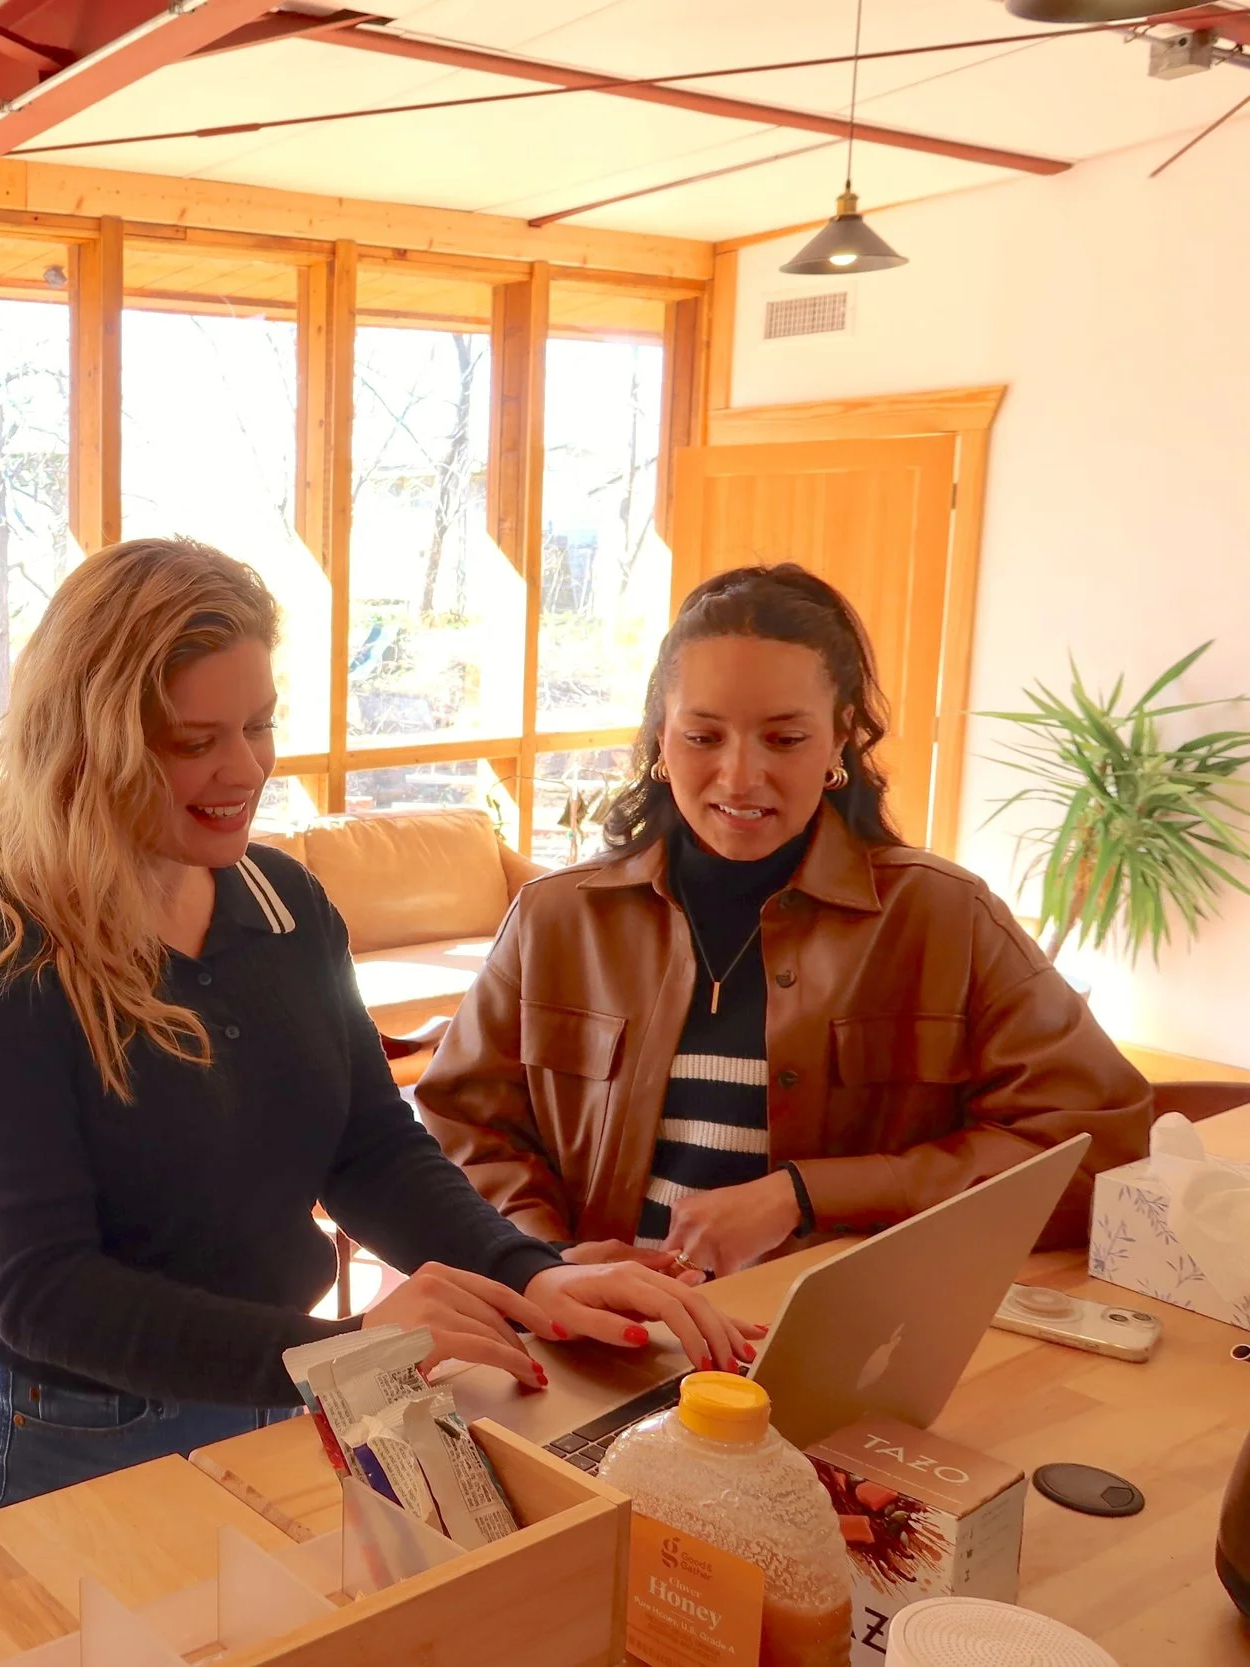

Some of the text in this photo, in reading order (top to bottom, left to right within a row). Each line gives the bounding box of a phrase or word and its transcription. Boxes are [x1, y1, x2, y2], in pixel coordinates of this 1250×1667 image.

[863, 1433, 970, 1484] TAZO
[649, 1575, 722, 1630] Honey
[669, 1577, 702, 1599] Clover
